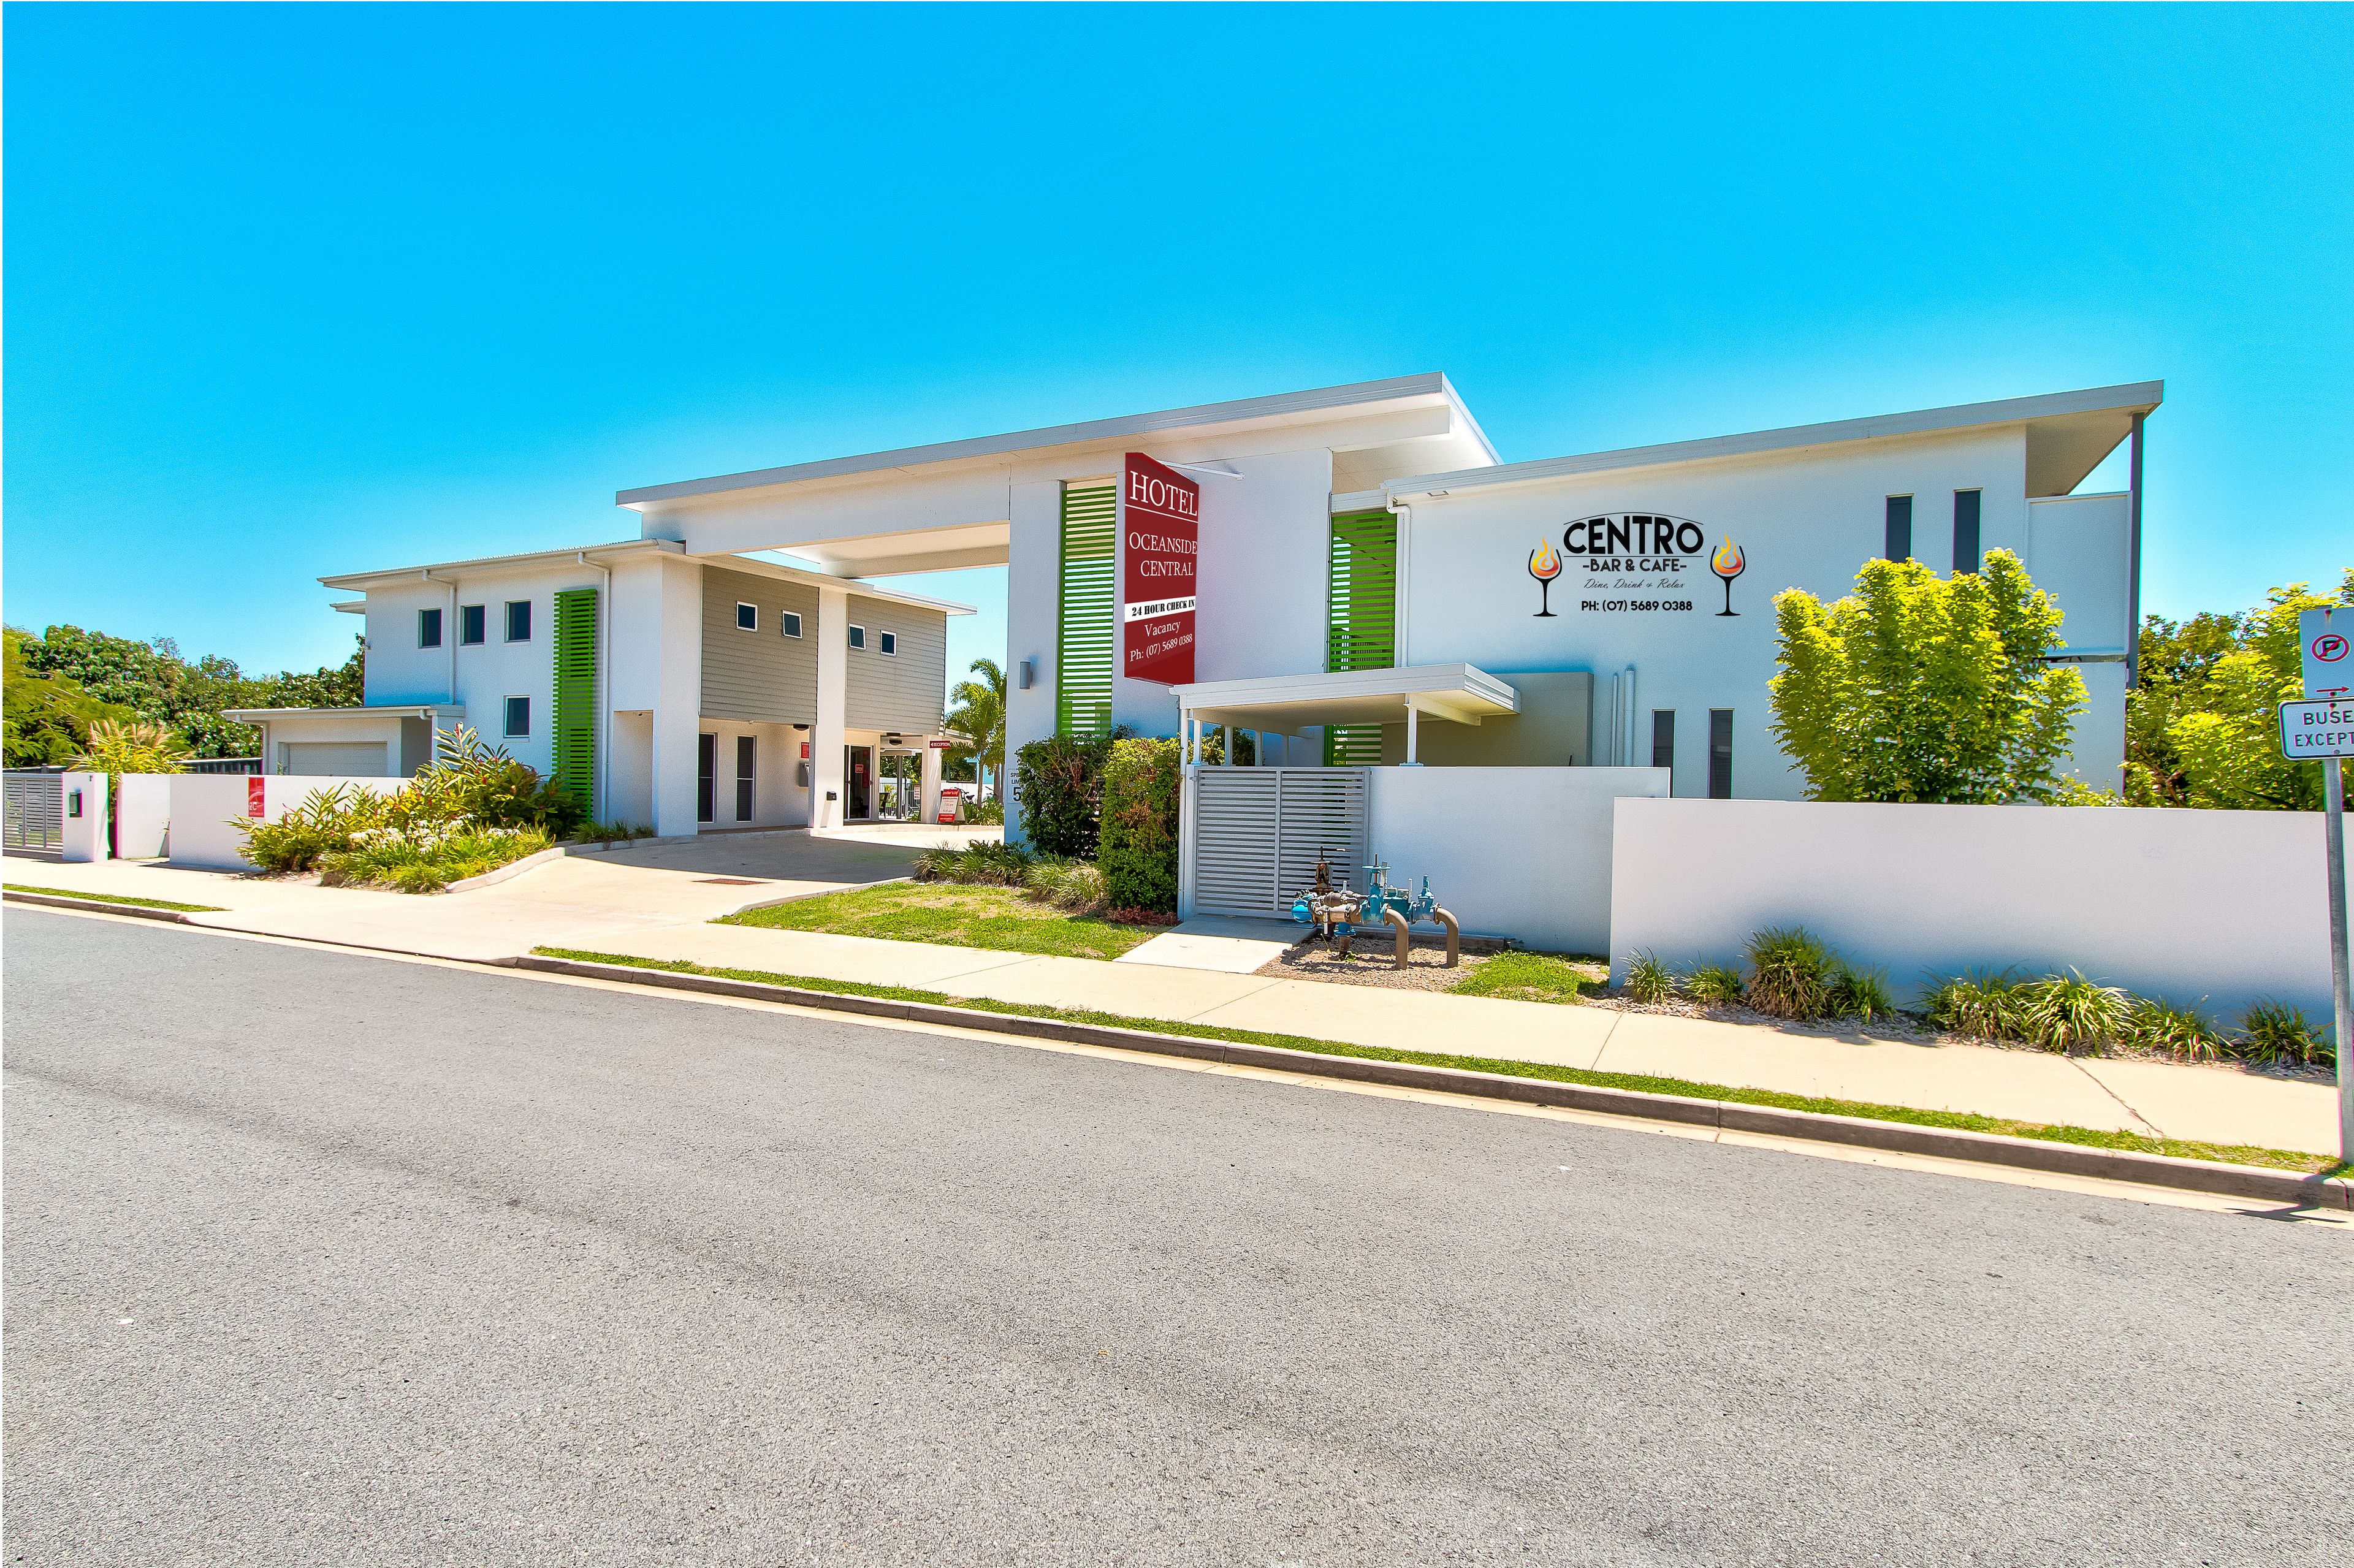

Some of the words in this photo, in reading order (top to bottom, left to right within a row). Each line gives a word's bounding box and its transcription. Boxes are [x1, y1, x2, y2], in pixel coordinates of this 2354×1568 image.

[1130, 470, 1197, 516] HOTEL
[1563, 516, 1704, 554] CENTRO
[1129, 532, 1197, 554] OCEANSIDE
[1140, 560, 1194, 576] CENTRAL
[1625, 558, 1635, 572] &
[1583, 578, 1609, 589] Dine,
[1613, 578, 1645, 588] Drink
[1657, 578, 1686, 588] Relax
[1132, 606, 1142, 617] 24
[1145, 603, 1165, 615] HOUR
[1167, 600, 1187, 611] CHECK
[1582, 601, 1599, 611] PH:
[1602, 599, 1628, 612] (07)
[1631, 601, 1659, 611] 5689
[1662, 601, 1693, 611] 0388
[1145, 622, 1181, 637] Vacancy
[1130, 649, 1145, 662] Ph:
[1146, 642, 1161, 659] (07)
[1162, 638, 1178, 652] 5689
[1179, 633, 1193, 646] 0388
[2303, 710, 2354, 725] BUSE
[2294, 732, 2354, 747] EXCEPT
[1013, 787, 1023, 801] 5
